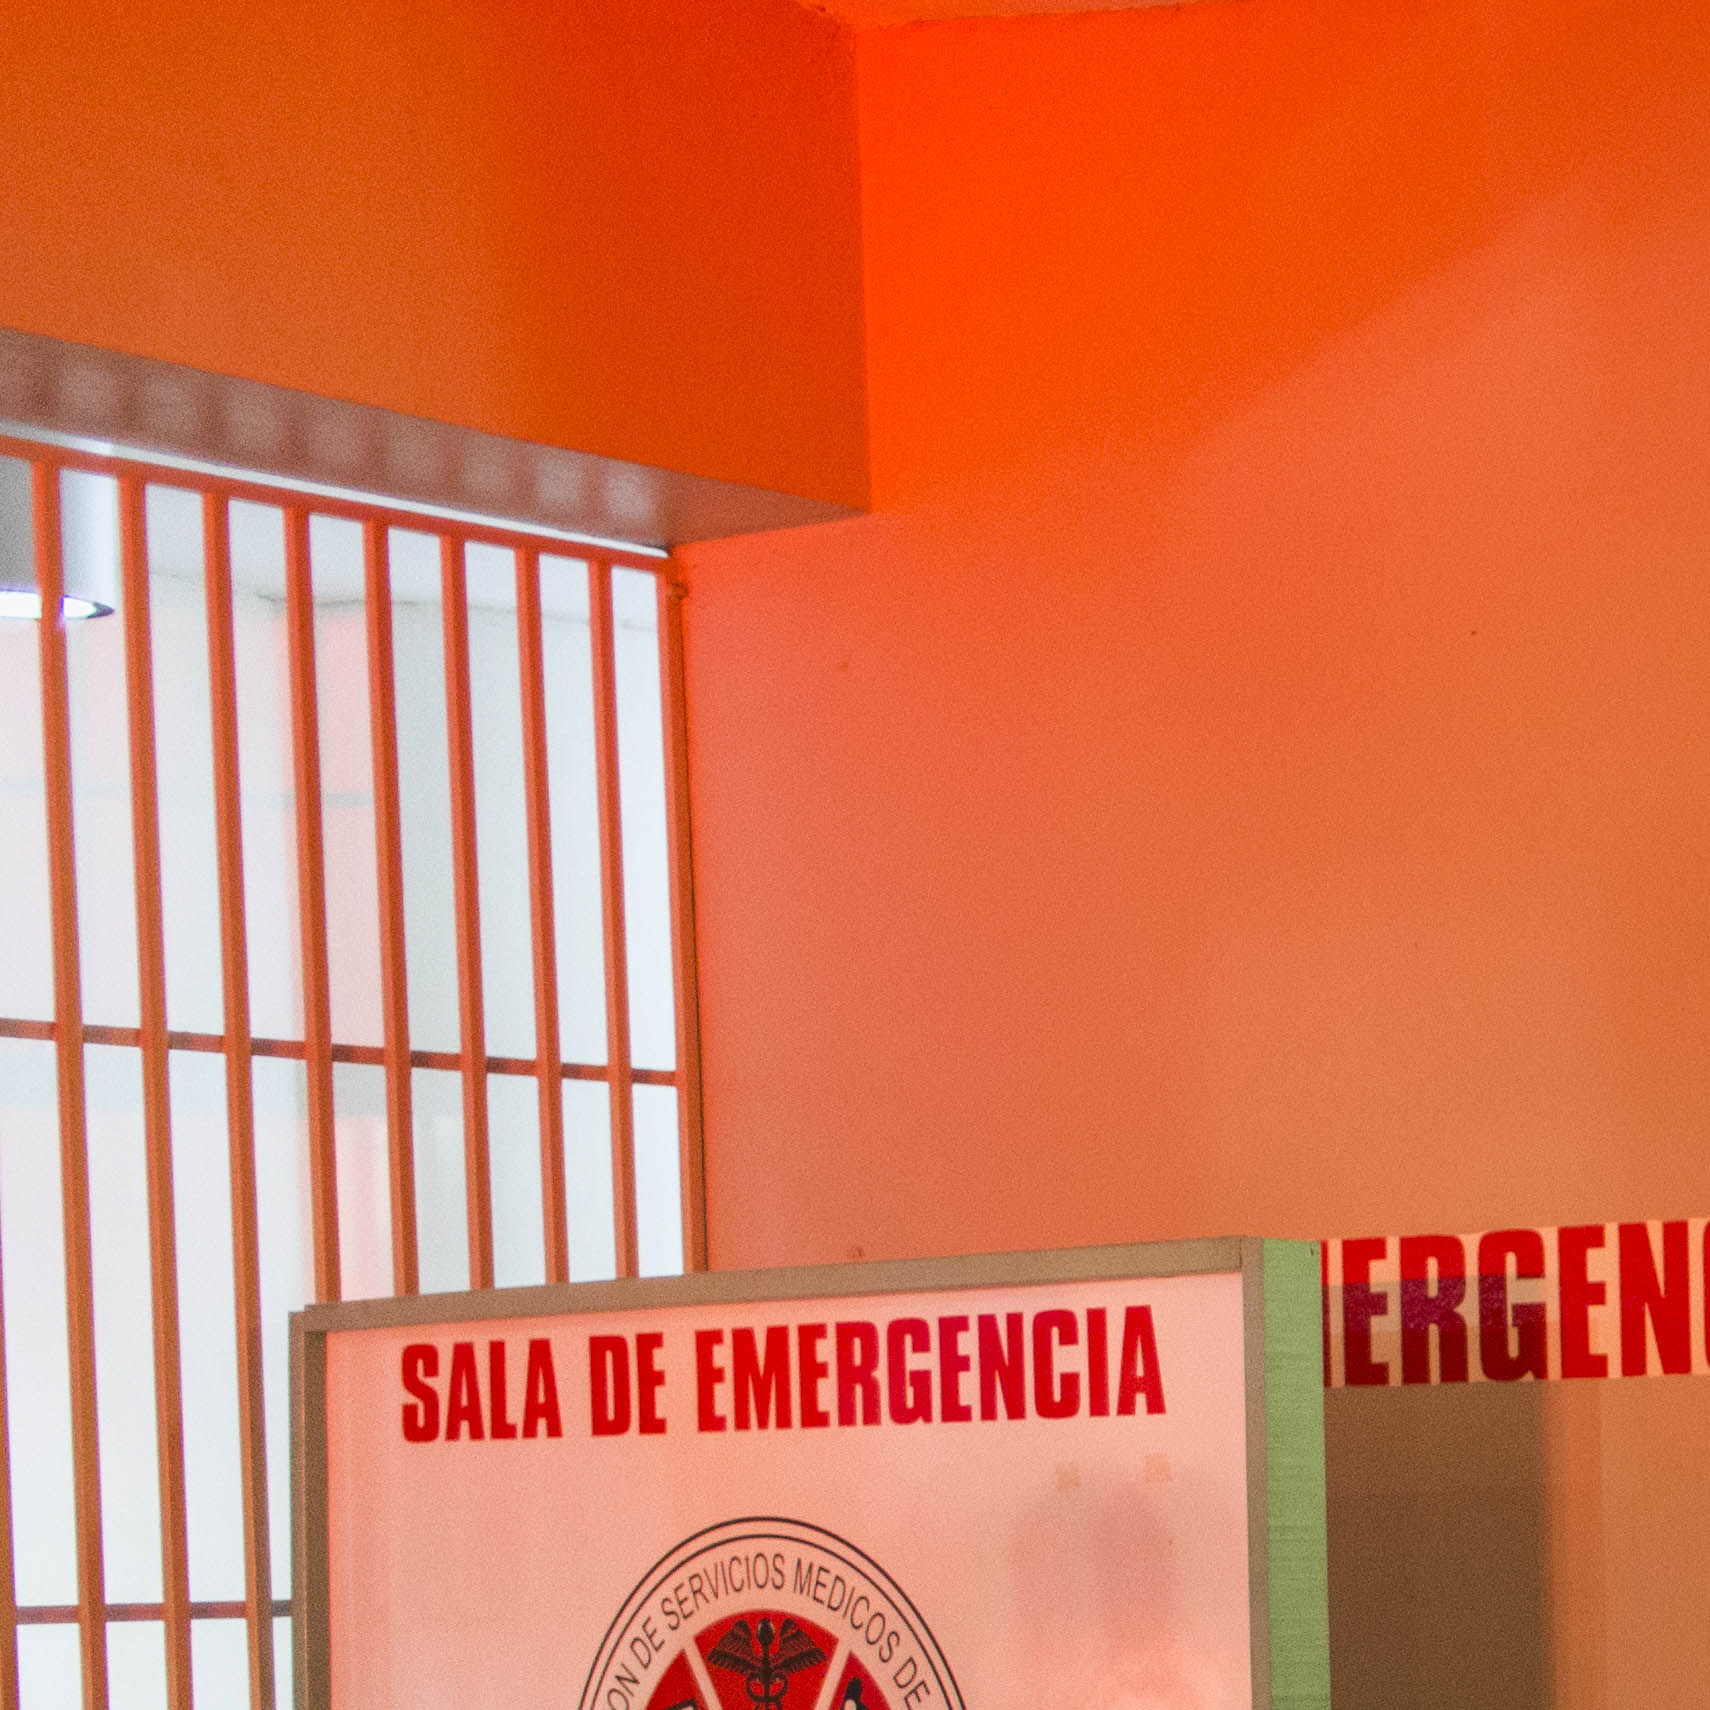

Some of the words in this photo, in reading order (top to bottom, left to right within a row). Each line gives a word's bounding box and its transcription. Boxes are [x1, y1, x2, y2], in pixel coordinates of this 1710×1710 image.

[402, 1338, 563, 1442] SALA
[588, 1332, 667, 1436] DE
[694, 1304, 1167, 1433] EMERGENCIA
[630, 1615, 666, 1671] DE
[661, 1552, 785, 1631] SERVICIOS
[793, 1557, 900, 1663] MEDICOS
